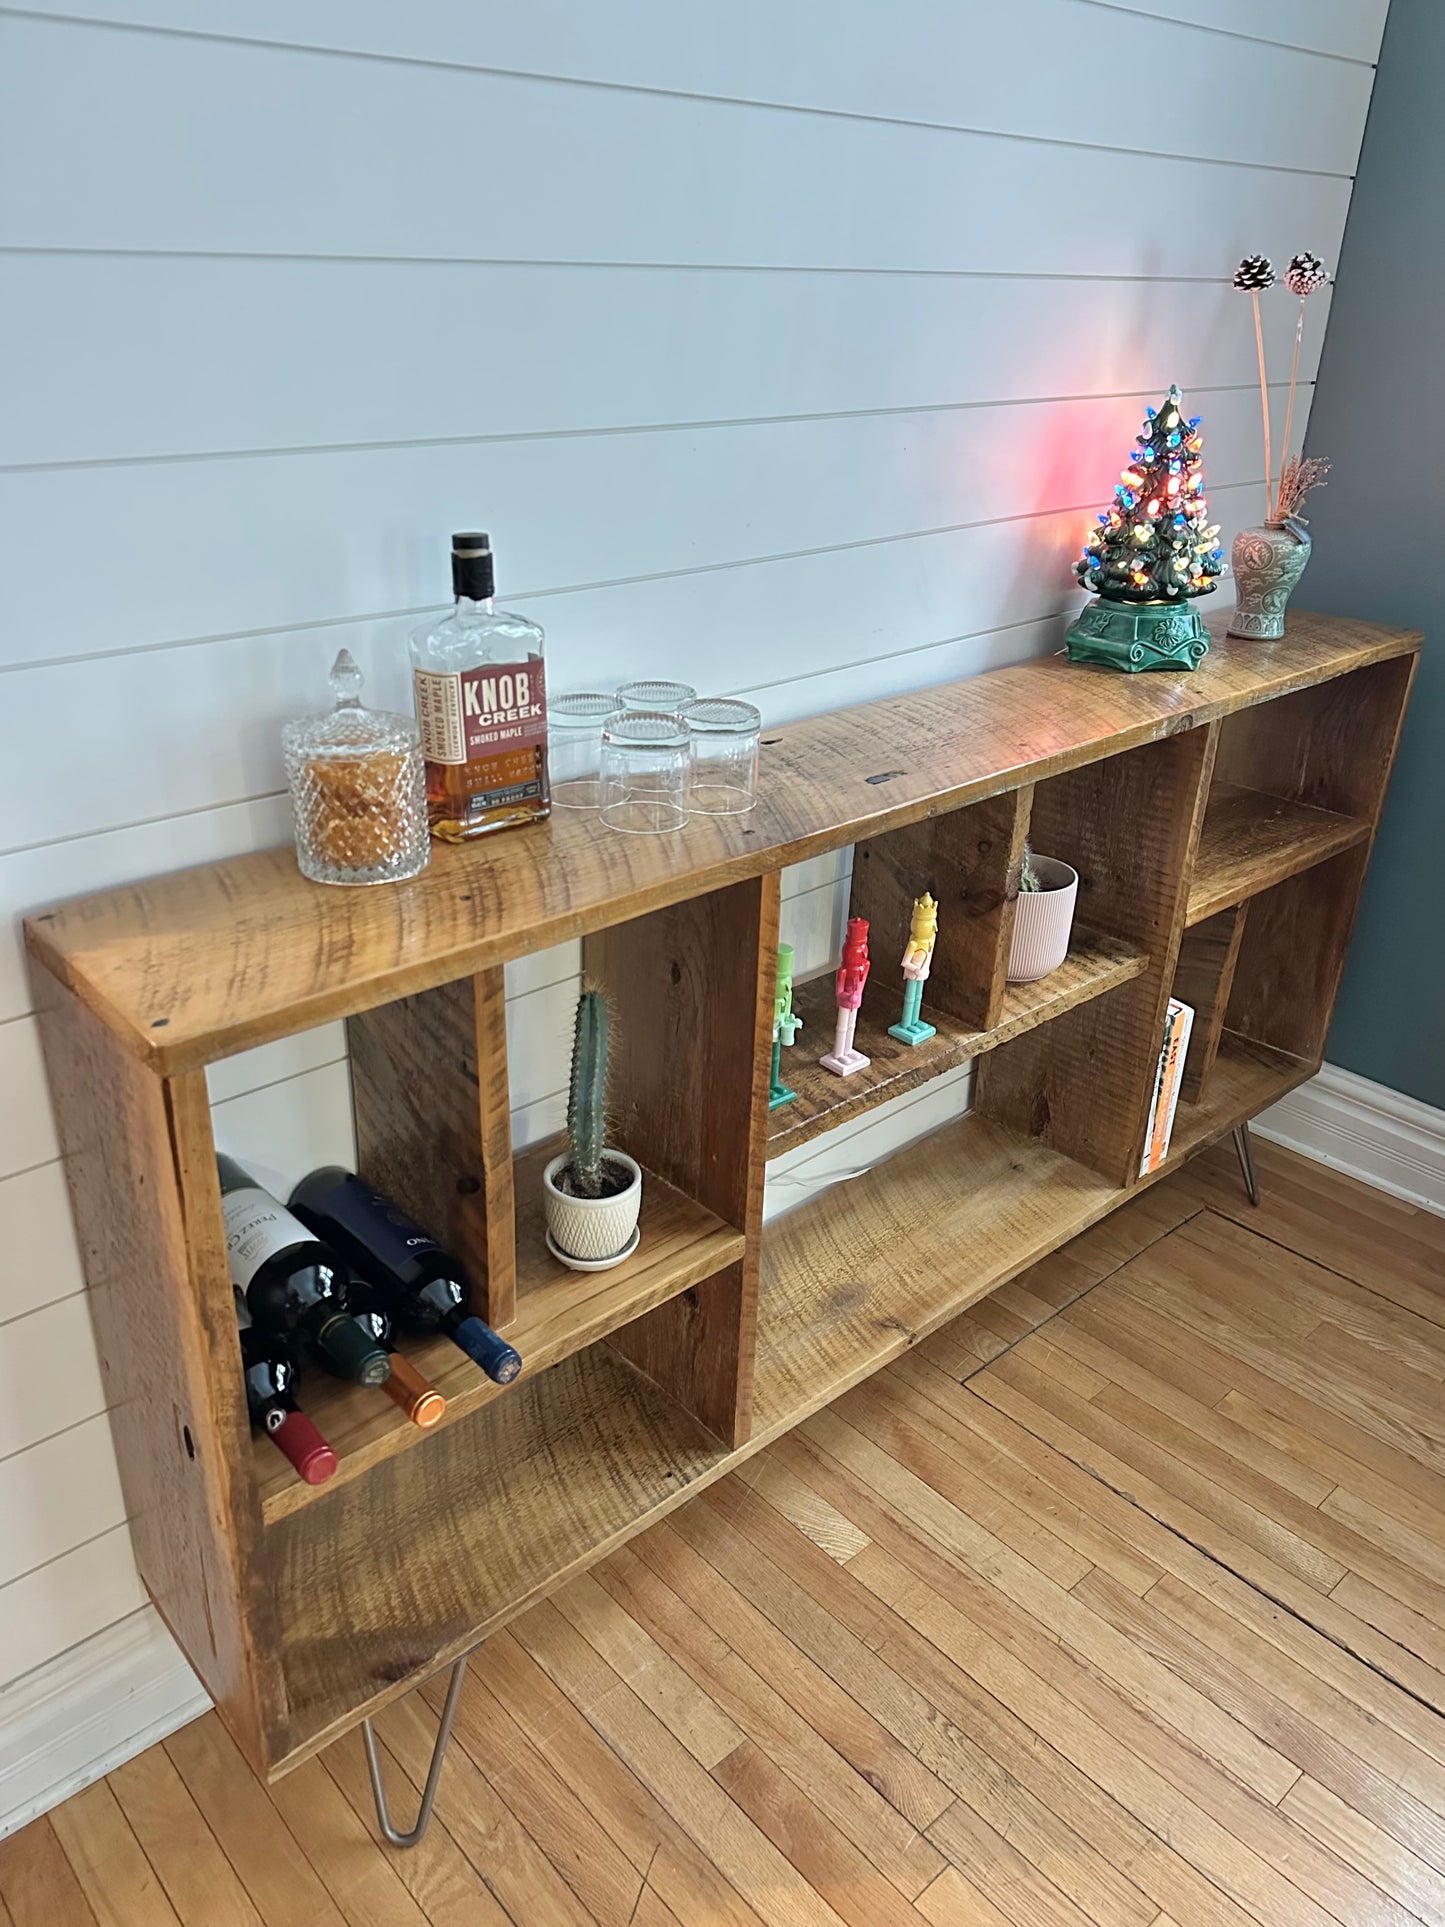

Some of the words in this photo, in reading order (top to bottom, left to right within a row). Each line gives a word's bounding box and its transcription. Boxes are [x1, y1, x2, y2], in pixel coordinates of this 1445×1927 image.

[420, 677, 429, 718] CREEK
[432, 679, 443, 714] MAPLE
[464, 672, 530, 716] KNOB
[479, 703, 542, 726] CREEK
[423, 720, 433, 754] KNOB
[434, 717, 447, 757] SMOKED
[470, 731, 499, 746] SMOKED
[500, 726, 523, 740] MAPLE
[1169, 1037, 1180, 1066] EAST
